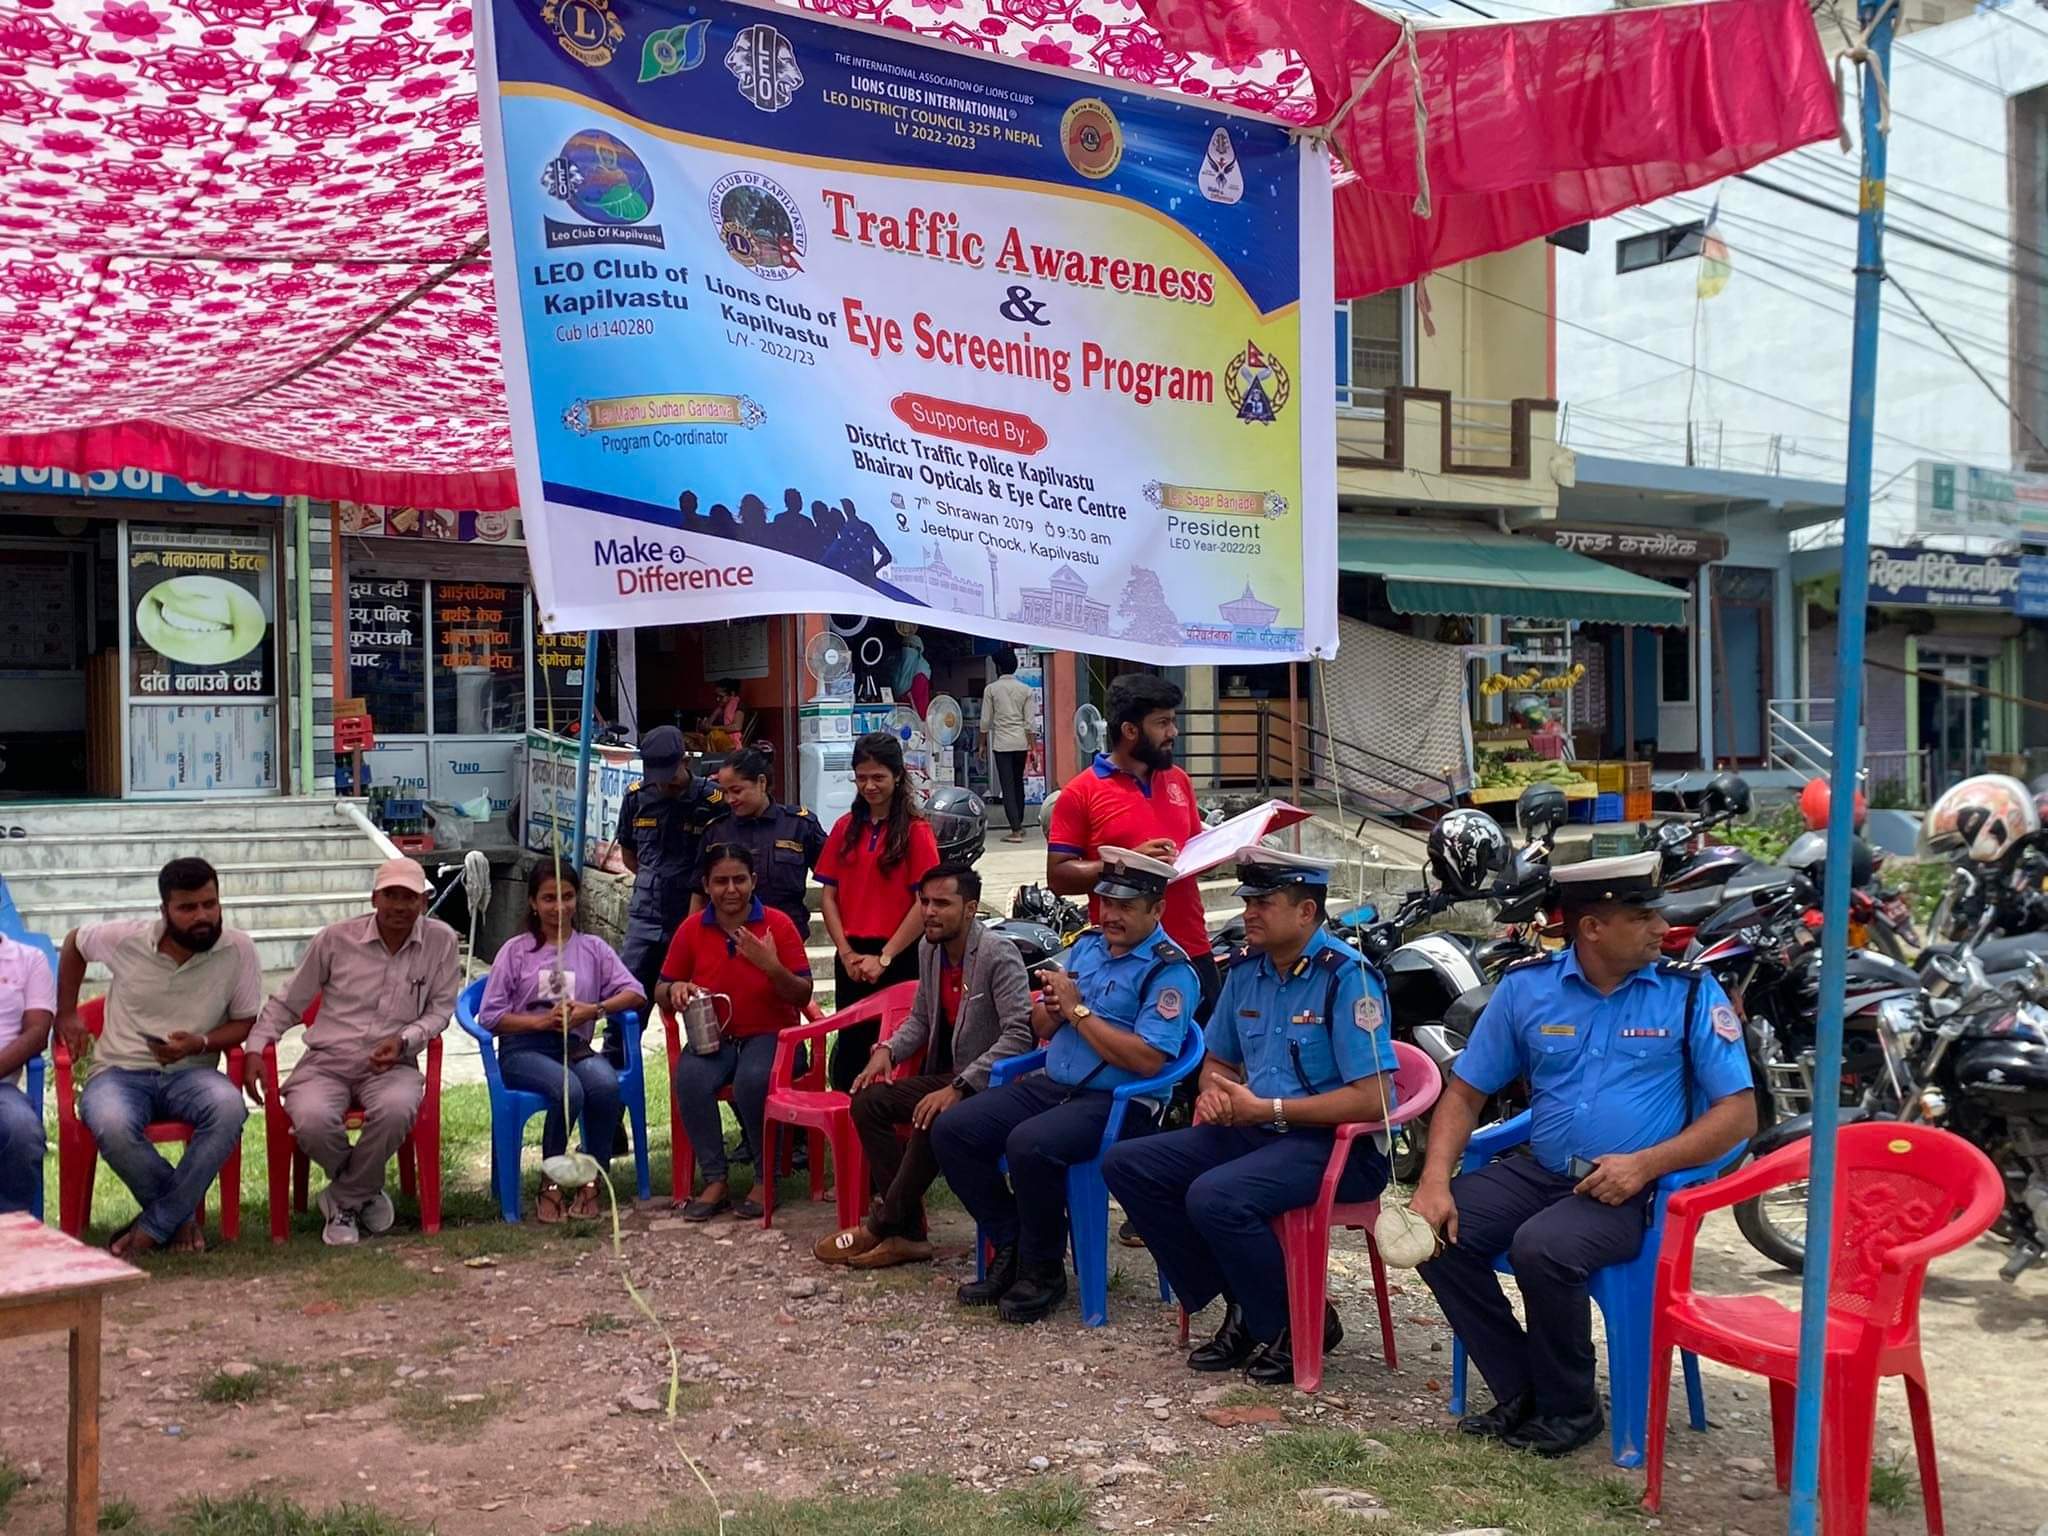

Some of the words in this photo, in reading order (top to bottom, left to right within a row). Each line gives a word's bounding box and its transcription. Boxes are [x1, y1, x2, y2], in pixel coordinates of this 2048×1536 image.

[758, 31, 772, 100] LEO
[835, 53, 850, 65] THE
[853, 56, 917, 80] INTERNATIONAL
[919, 72, 971, 91] ASSOCIATION
[973, 84, 985, 94] OF
[985, 87, 1008, 100] LIONS
[1010, 92, 1034, 105] CLUBS
[851, 75, 885, 96] LIONS
[887, 84, 922, 103] CLUBS
[823, 90, 848, 106] LEO
[851, 95, 908, 119] DISTRICT
[911, 109, 965, 132] COUNCIL
[969, 120, 990, 137] 325
[1005, 129, 1043, 148] NEPAL
[895, 121, 909, 135] LY
[912, 125, 976, 149] 2022-2023
[557, 160, 567, 196] LEO
[716, 175, 742, 194] CLUB
[744, 174, 760, 184] OF
[762, 179, 805, 249] KAPILVASTU
[551, 231, 570, 242] Leo
[572, 228, 596, 240] Club
[598, 227, 610, 238] Of
[612, 227, 663, 244] Kapilvastu
[822, 188, 984, 267] Traffic
[995, 226, 1214, 303] Awareness
[534, 265, 585, 286] LEO
[594, 259, 658, 281] Club
[665, 266, 689, 284] of
[543, 290, 689, 316] Kapilvastu
[704, 275, 760, 306] Lions
[765, 294, 812, 322] Club
[817, 311, 838, 328] of
[999, 285, 1052, 327] &
[556, 324, 582, 342] Cub
[720, 303, 829, 350] Kapilvastu
[759, 338, 816, 367] 2022/23
[842, 296, 904, 358] Eye
[912, 312, 1072, 394] Screening
[1082, 341, 1215, 405] Program
[911, 402, 999, 439] Supported
[1003, 420, 1031, 448] By:
[601, 434, 650, 455] Program
[653, 428, 728, 448] Co-ordinator
[845, 423, 908, 455] District
[911, 438, 964, 467] Traffic
[968, 451, 1014, 478] Police
[1018, 461, 1094, 493] Kapilvastu
[852, 450, 913, 482] Bhairav
[919, 465, 983, 495] Opticals
[988, 479, 1003, 499] &
[1007, 483, 1034, 508] Eye
[1039, 490, 1072, 513] Care
[1077, 500, 1127, 521] Centre
[1186, 491, 1214, 510] Sagar
[936, 500, 999, 527] Shrawan
[1002, 514, 1034, 534] 2079
[1057, 526, 1087, 543] 9:30
[1090, 532, 1112, 547] am
[1168, 515, 1260, 539] President
[594, 535, 663, 567] Make
[670, 545, 686, 564] a
[920, 520, 975, 543] Jeetpur
[978, 530, 1027, 554] Chock,
[1029, 540, 1099, 567] Kapilvastu
[1170, 537, 1191, 550] LEO
[1194, 539, 1262, 555] Year-2022/23
[161, 550, 225, 570] मनकामना
[616, 564, 754, 596] Difference
[349, 629, 414, 648] कुराउनी
[175, 670, 229, 692] बनाउने
[234, 670, 263, 692] ठाउँ
[448, 760, 480, 775] RINO
